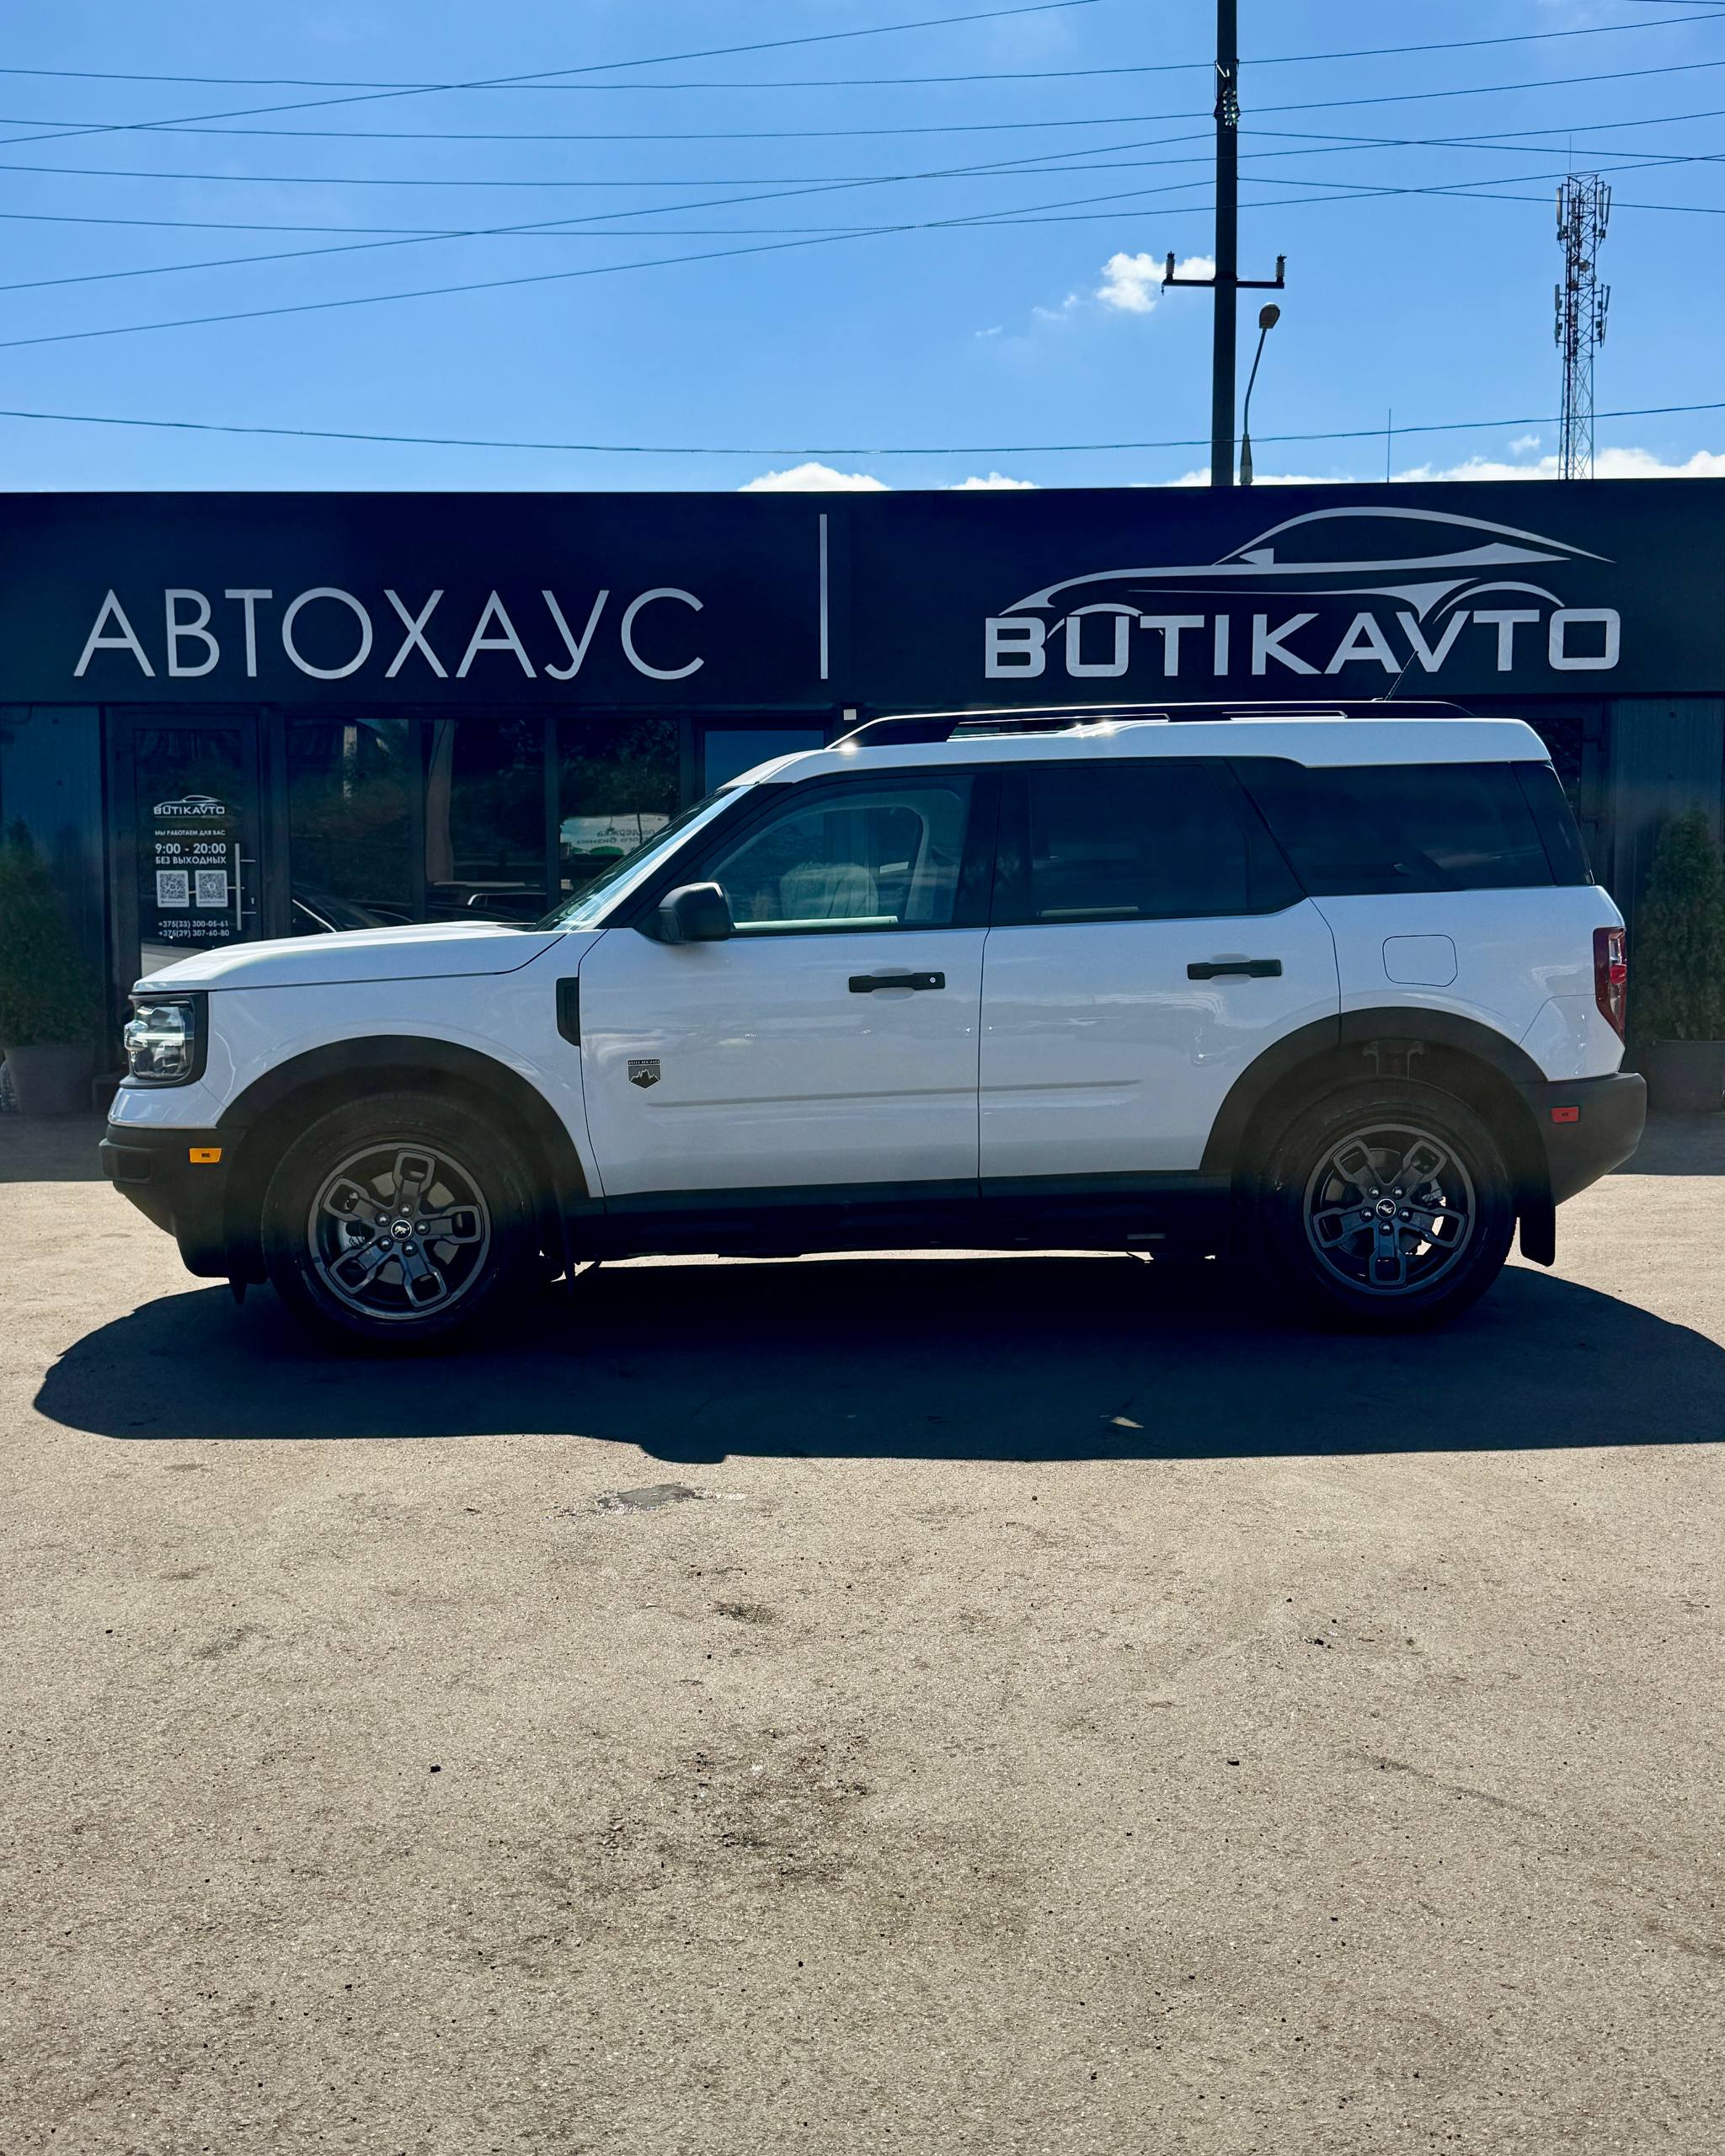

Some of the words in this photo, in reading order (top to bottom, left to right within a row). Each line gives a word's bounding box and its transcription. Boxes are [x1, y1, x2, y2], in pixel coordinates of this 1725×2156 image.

[73, 587, 706, 680] АВТОХАУС
[985, 607, 1621, 678] BUTIKAVTO
[153, 806, 226, 814] BUTIKAVTO
[155, 843, 181, 854] 9:00
[193, 843, 227, 854] 20:00
[155, 856, 171, 864] БЕЗ
[173, 856, 227, 864] ВЫХОДНЫХ
[158, 920, 190, 928] +375(33)
